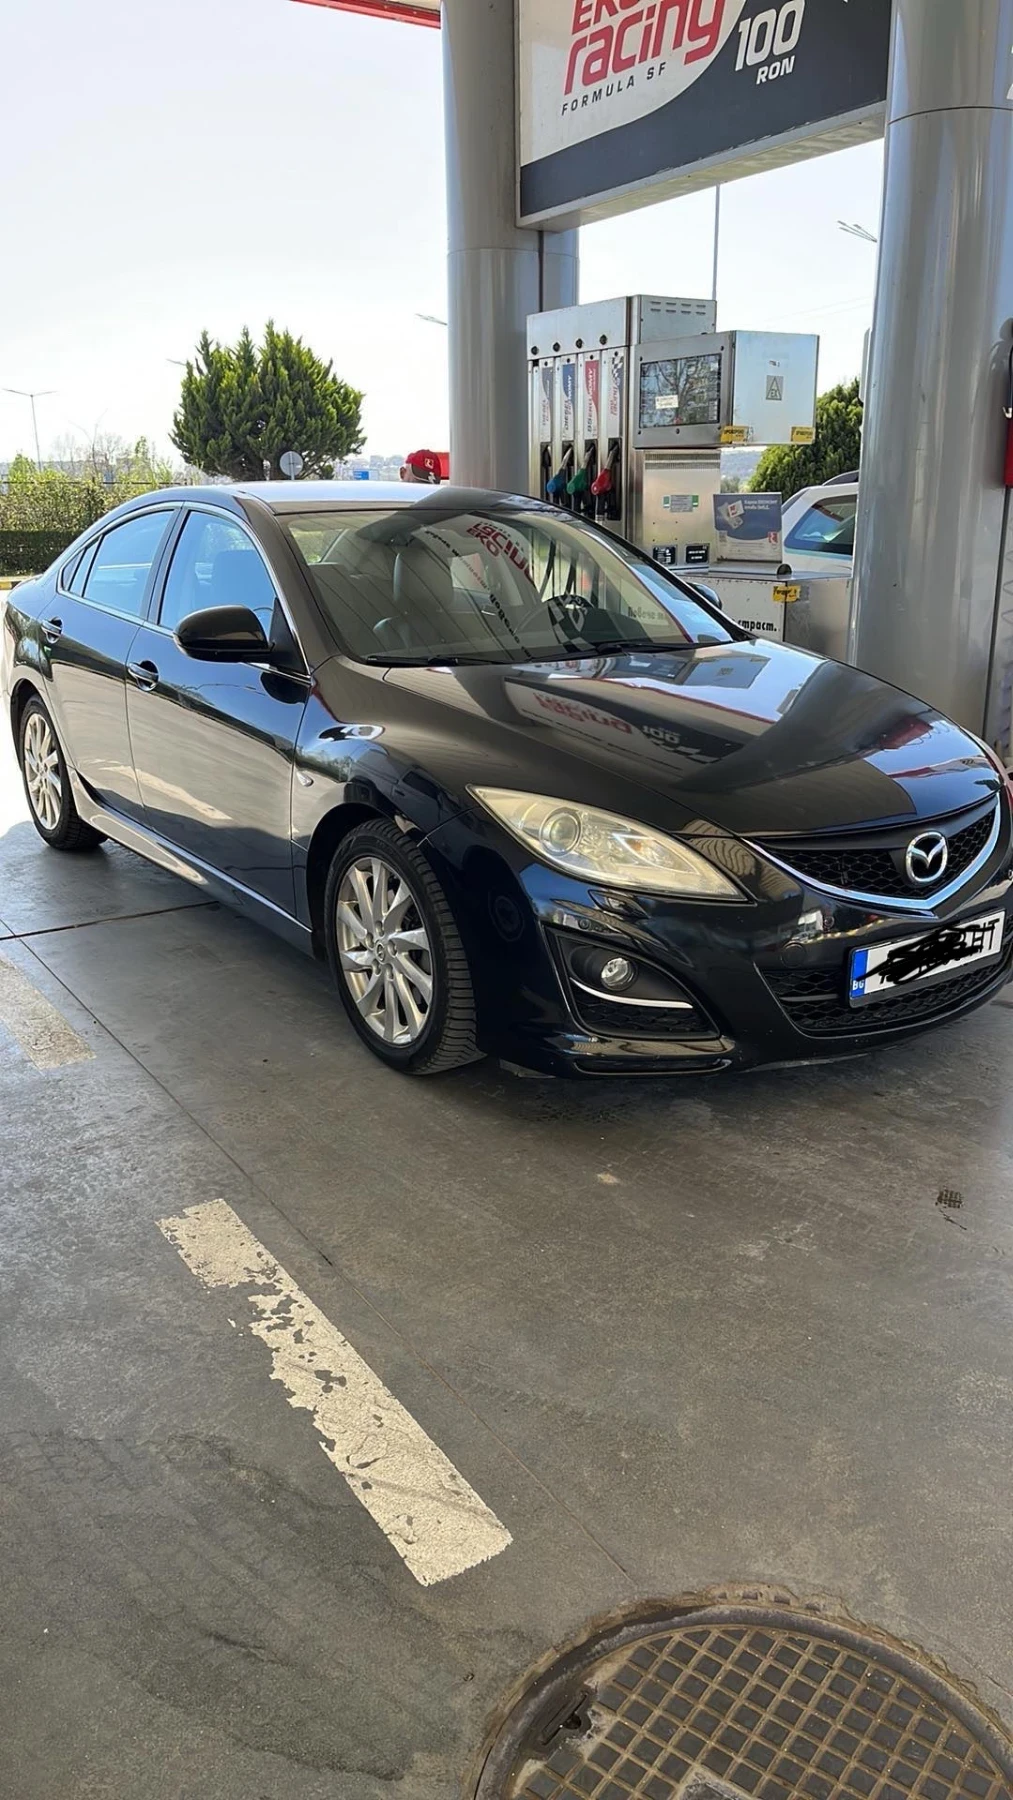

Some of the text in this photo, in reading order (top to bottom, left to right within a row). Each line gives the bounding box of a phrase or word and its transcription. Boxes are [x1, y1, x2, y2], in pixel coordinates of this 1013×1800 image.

[571, 0, 640, 35] EK
[735, 0, 806, 72] 100
[564, 0, 726, 96] racing
[756, 56, 796, 85] RON
[561, 61, 667, 116] FORMULA SF
[852, 979, 865, 991] BG
